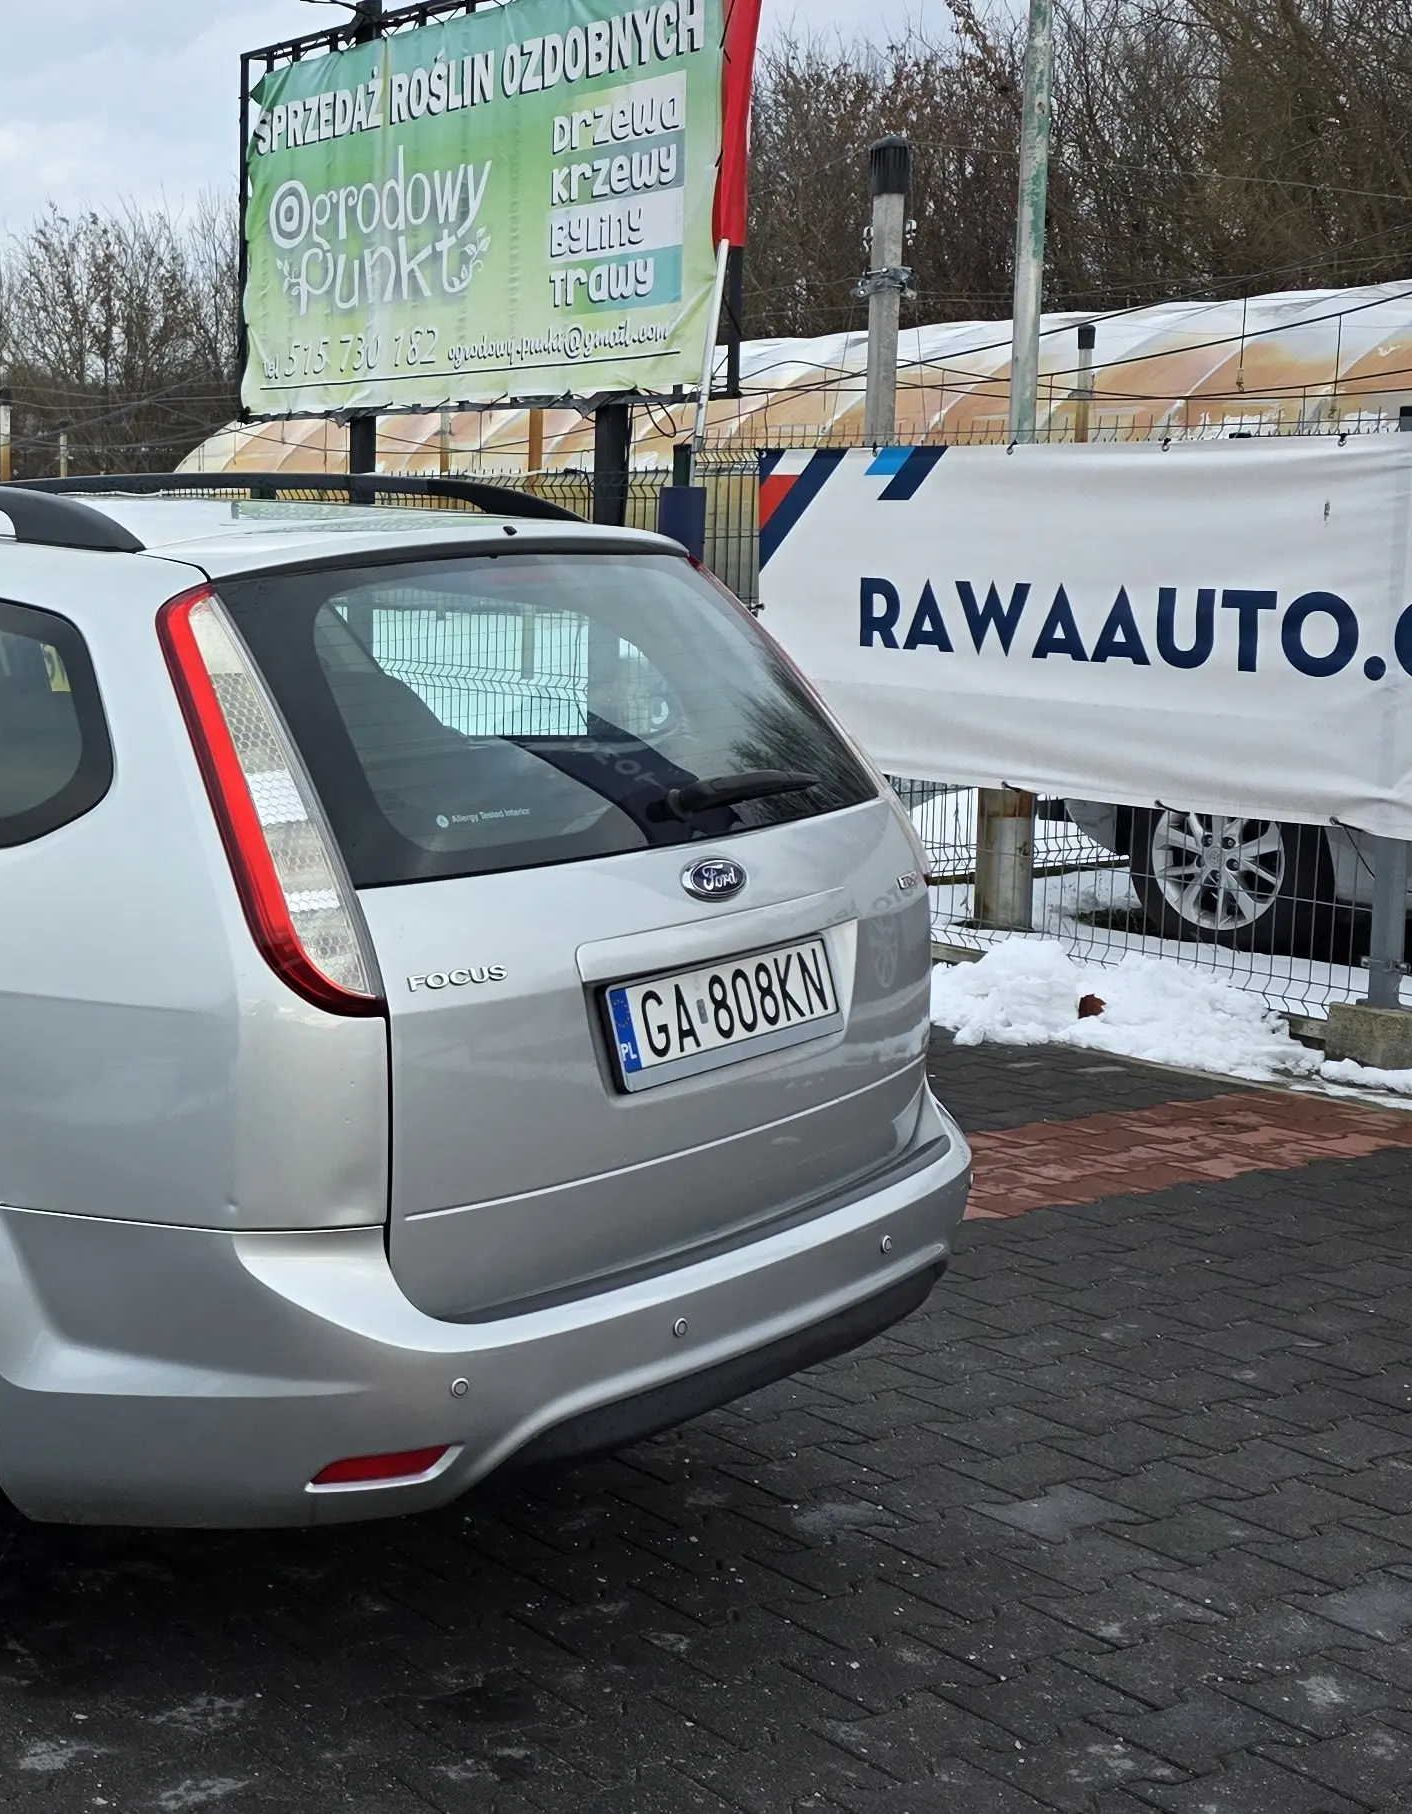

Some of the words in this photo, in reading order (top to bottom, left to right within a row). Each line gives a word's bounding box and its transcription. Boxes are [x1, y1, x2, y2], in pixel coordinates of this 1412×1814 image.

[252, 66, 384, 156] SPRZEDAŻ
[389, 50, 494, 125] ROŚLIN
[501, 0, 705, 98] OZDOBNYCH
[269, 144, 492, 250] Ogrodowy
[284, 338, 330, 378] 515
[340, 333, 381, 373] 730
[393, 325, 439, 368] 182
[859, 577, 1412, 682] RAWAAUTO.
[451, 814, 479, 824] Allergy
[479, 811, 505, 821] Tested
[702, 861, 739, 890] Ford
[407, 964, 509, 992] FOCUS
[641, 983, 702, 1059] GA
[708, 948, 829, 1040] 808KN
[620, 1042, 638, 1062] PL
